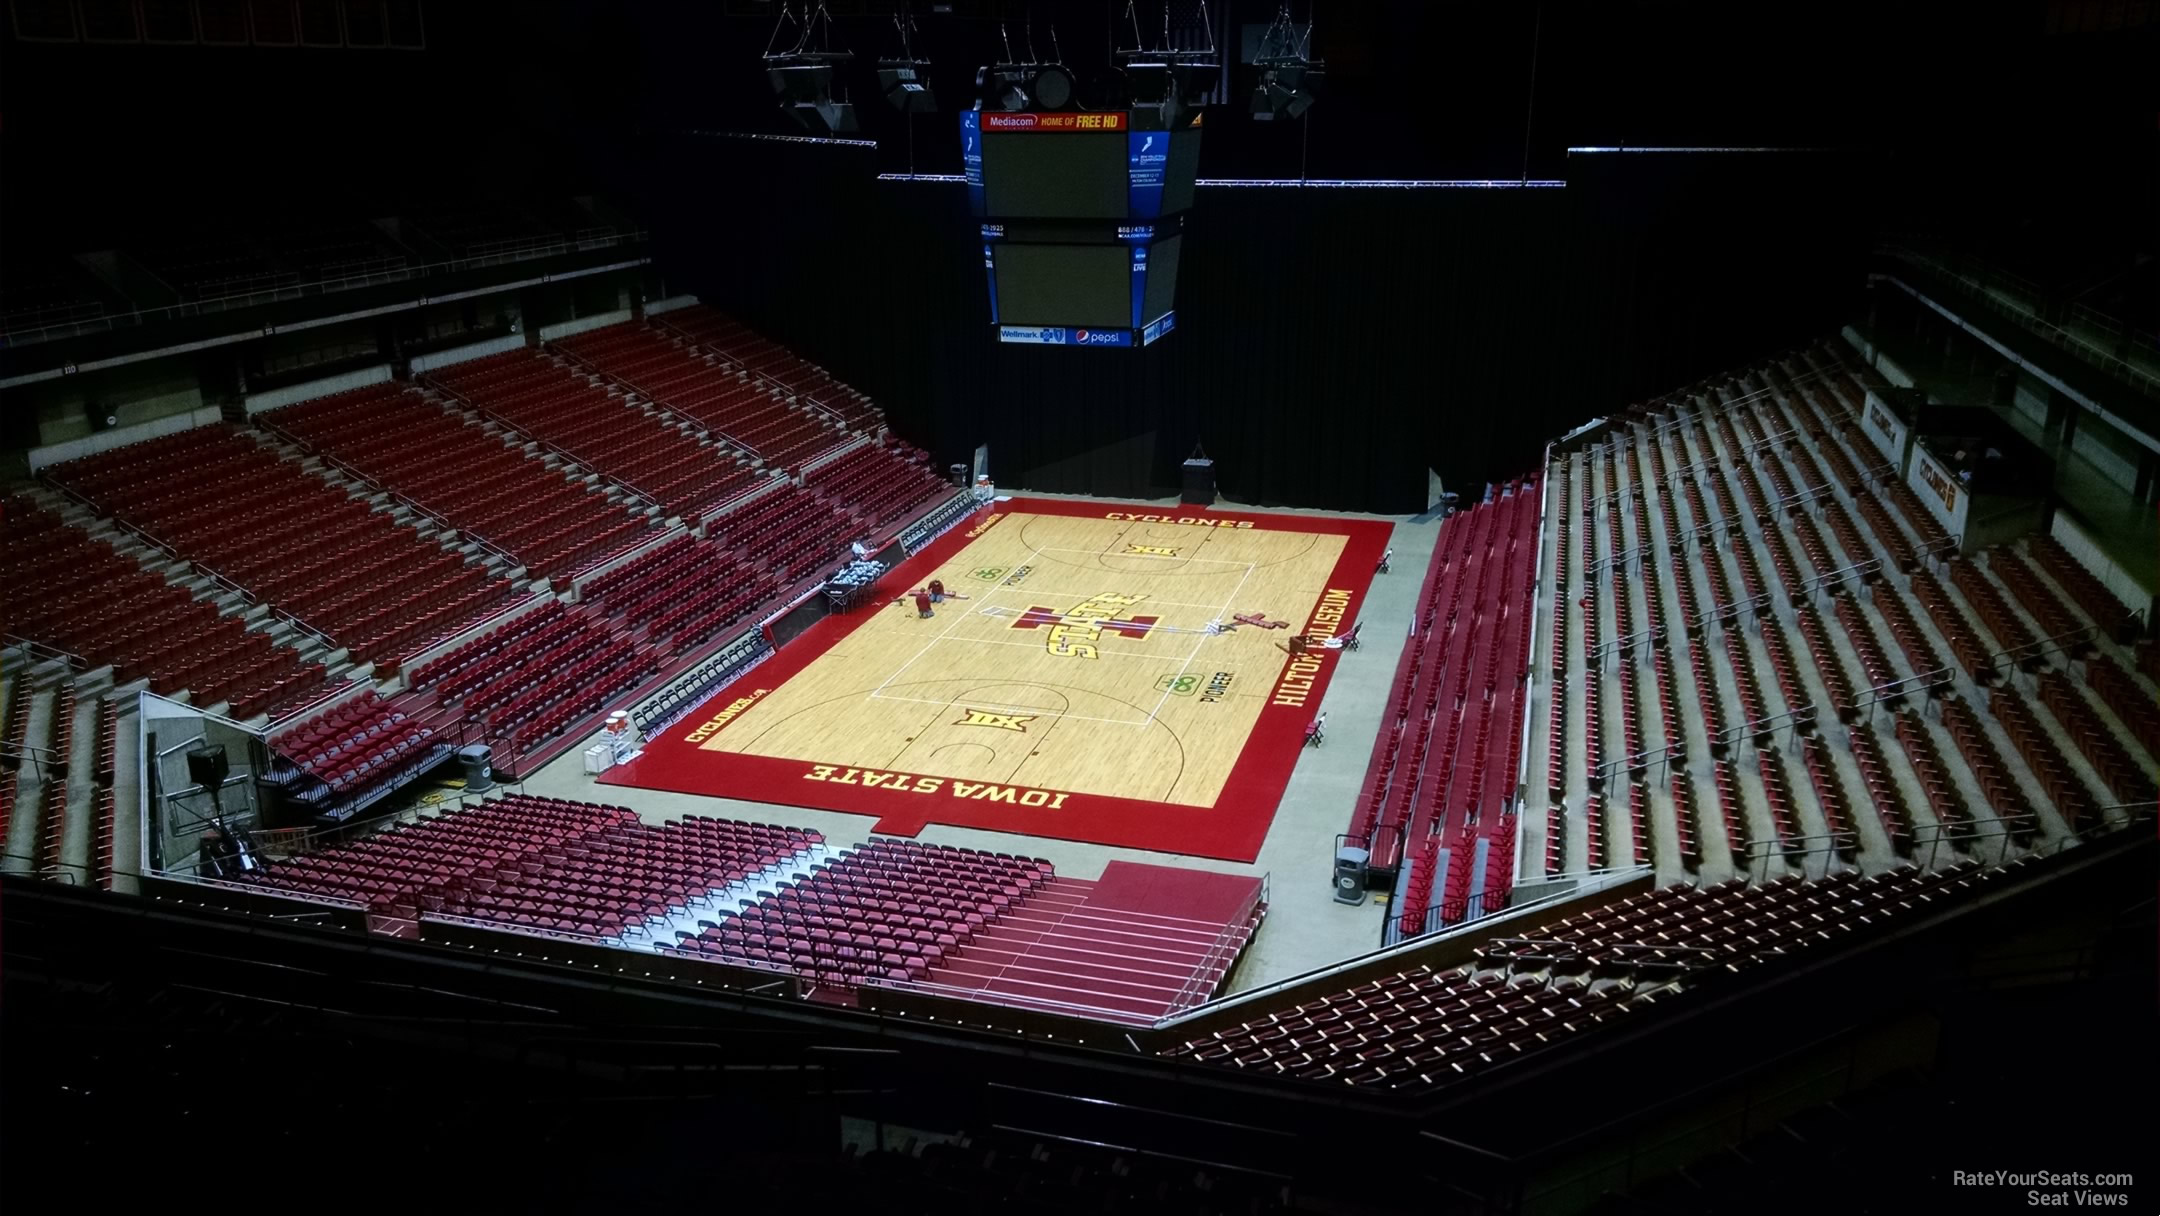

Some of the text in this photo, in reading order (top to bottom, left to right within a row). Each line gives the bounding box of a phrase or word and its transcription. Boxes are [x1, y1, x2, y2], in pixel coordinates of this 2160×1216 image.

[990, 115, 1118, 128] Mediacom HOME OF FREE HD
[1091, 332, 1119, 343] pepsi
[64, 365, 77, 375] 110
[1105, 512, 1255, 528] CYCLONES
[1046, 591, 1151, 660] STATE
[1200, 671, 1235, 703] PIONEER
[1272, 652, 1324, 707] HILTON
[803, 764, 1070, 809] IOWA STATE
